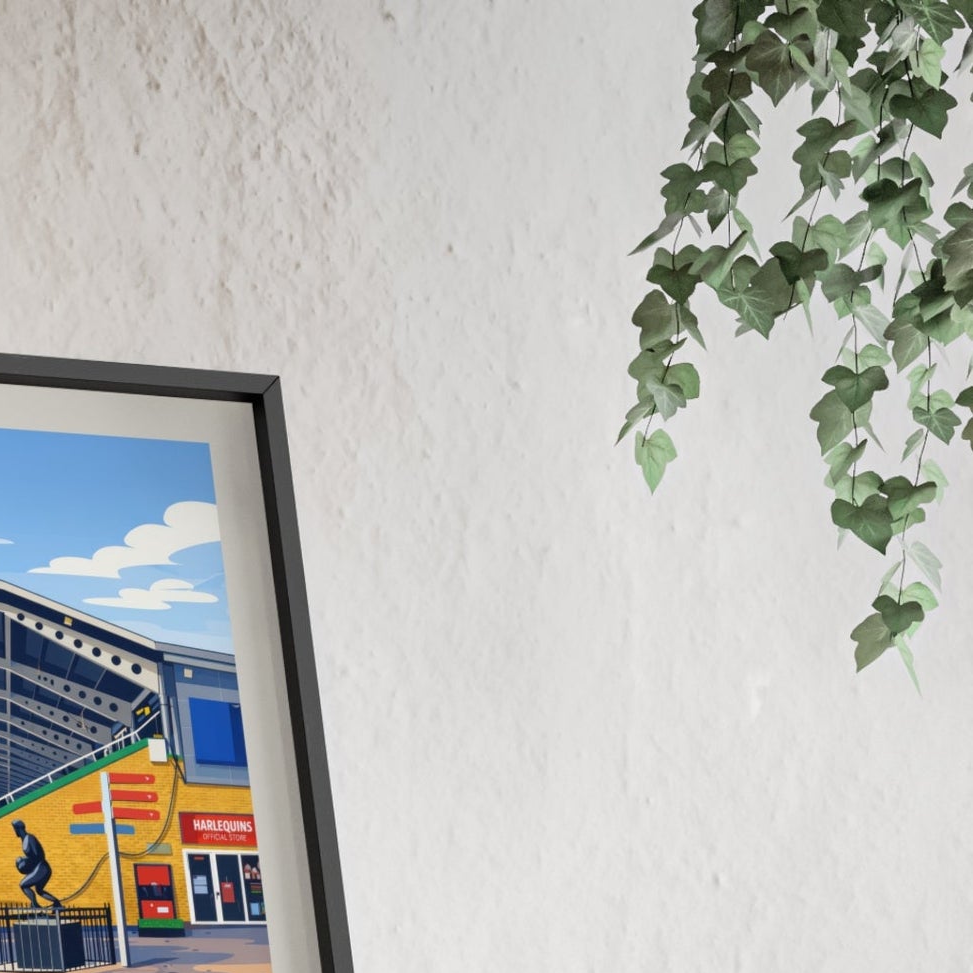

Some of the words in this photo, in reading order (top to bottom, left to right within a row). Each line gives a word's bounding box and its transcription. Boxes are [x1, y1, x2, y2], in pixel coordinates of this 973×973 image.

[193, 819, 253, 833] HARLEQUINS
[202, 833, 228, 841] OFFICIAL
[229, 834, 248, 842] STORE
